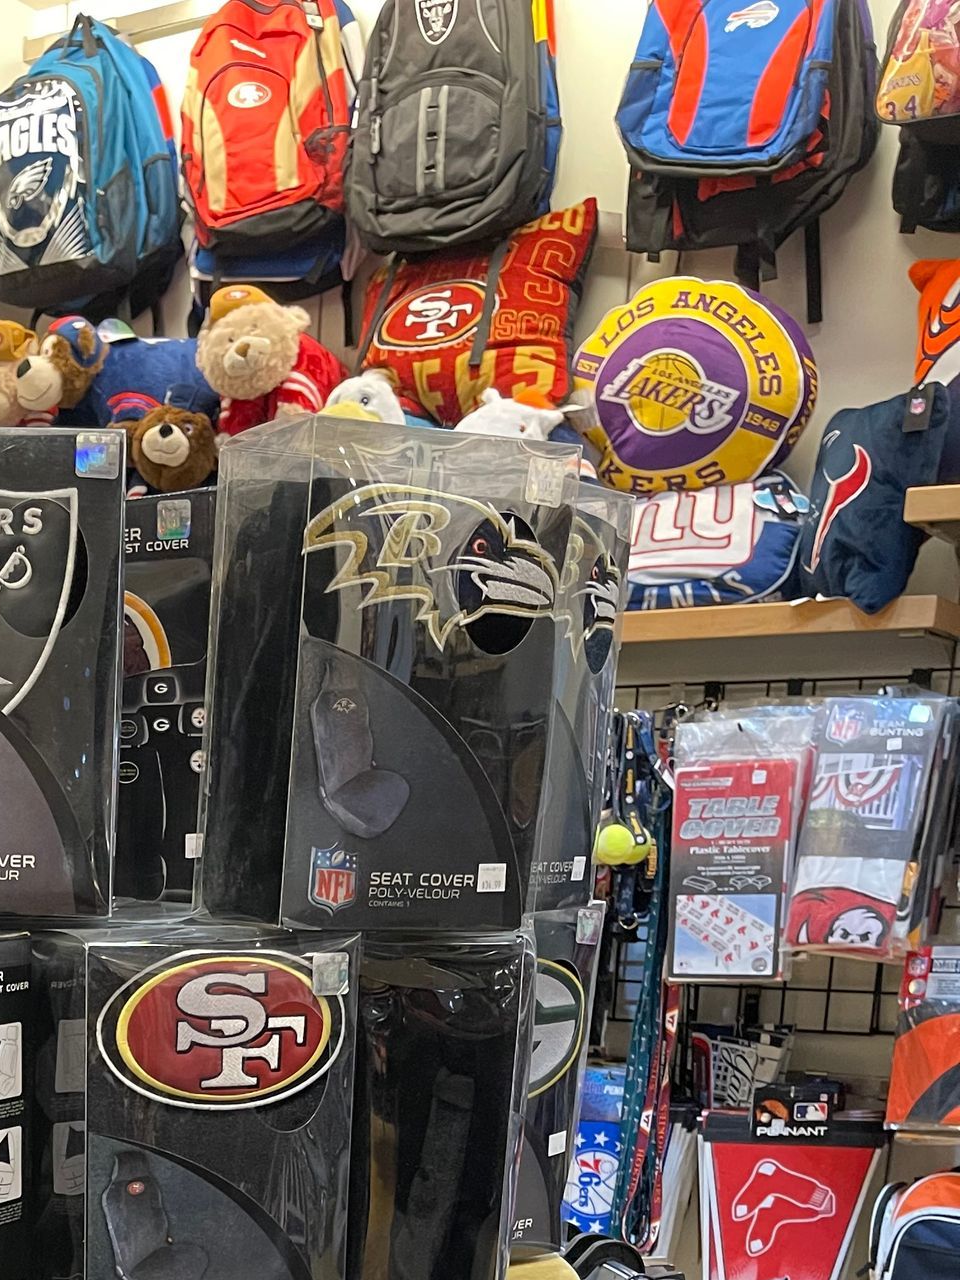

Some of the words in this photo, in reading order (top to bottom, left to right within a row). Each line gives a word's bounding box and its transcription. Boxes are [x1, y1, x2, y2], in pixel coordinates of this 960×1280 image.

[597, 296, 656, 349] LOS
[670, 290, 783, 398] ANGELES
[650, 367, 677, 380] LOS
[677, 375, 733, 400] ANGELES
[610, 363, 728, 430] LAKERS
[145, 538, 190, 552] COVER
[687, 795, 780, 818] TABLE
[679, 816, 781, 840] COVER
[689, 845, 721, 855] Plastic
[722, 844, 771, 855] Tablecover
[315, 869, 357, 904] NFL
[369, 872, 415, 886] SEAT
[418, 873, 475, 888] COVER
[368, 886, 461, 900] POLY-VELOUR
[368, 900, 405, 908] CONTAINS
[5, 981, 30, 992] COVER
[175, 972, 307, 1089] SF
